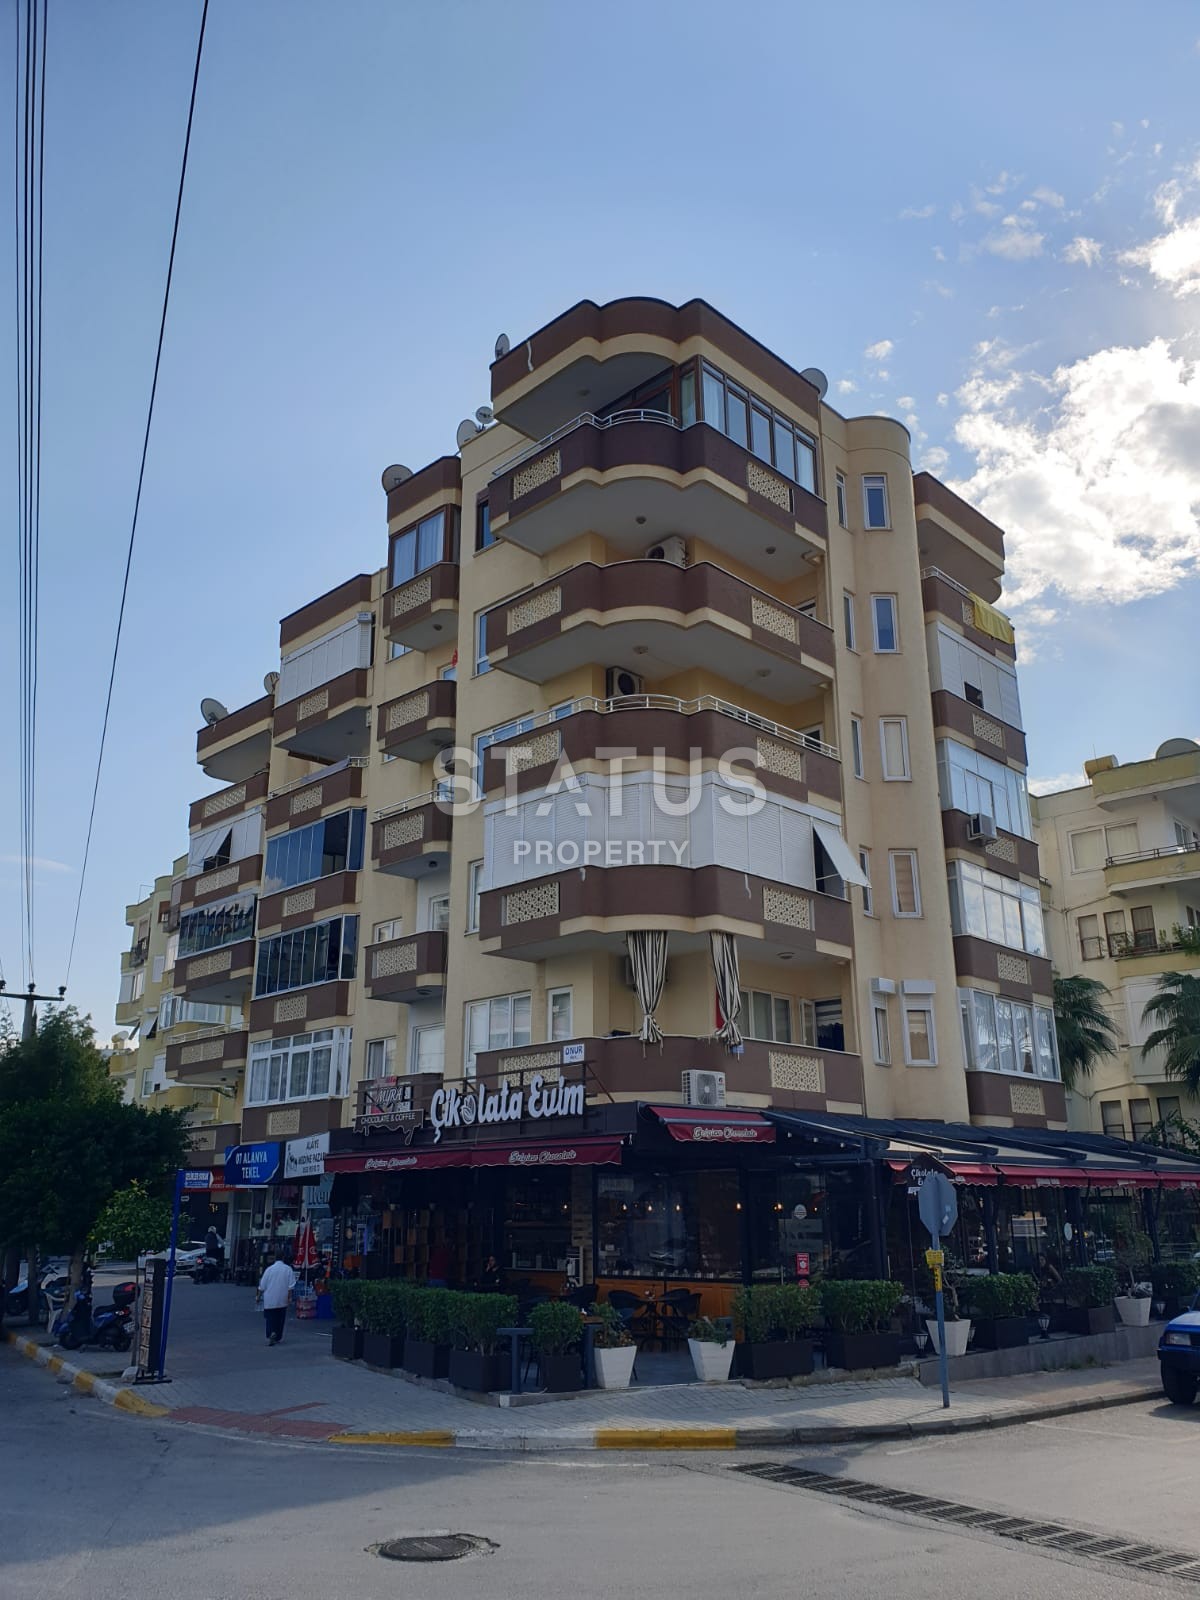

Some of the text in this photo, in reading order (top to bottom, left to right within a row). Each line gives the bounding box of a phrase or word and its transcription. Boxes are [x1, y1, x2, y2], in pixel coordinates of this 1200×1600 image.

[565, 1045, 583, 1056] ONUR
[527, 1074, 586, 1119] Evim
[360, 1115, 390, 1125] CHOCOLATE
[395, 1112, 416, 1121] COFFEE
[242, 1150, 268, 1165] ALANYA
[241, 1166, 260, 1179] TEKEL
